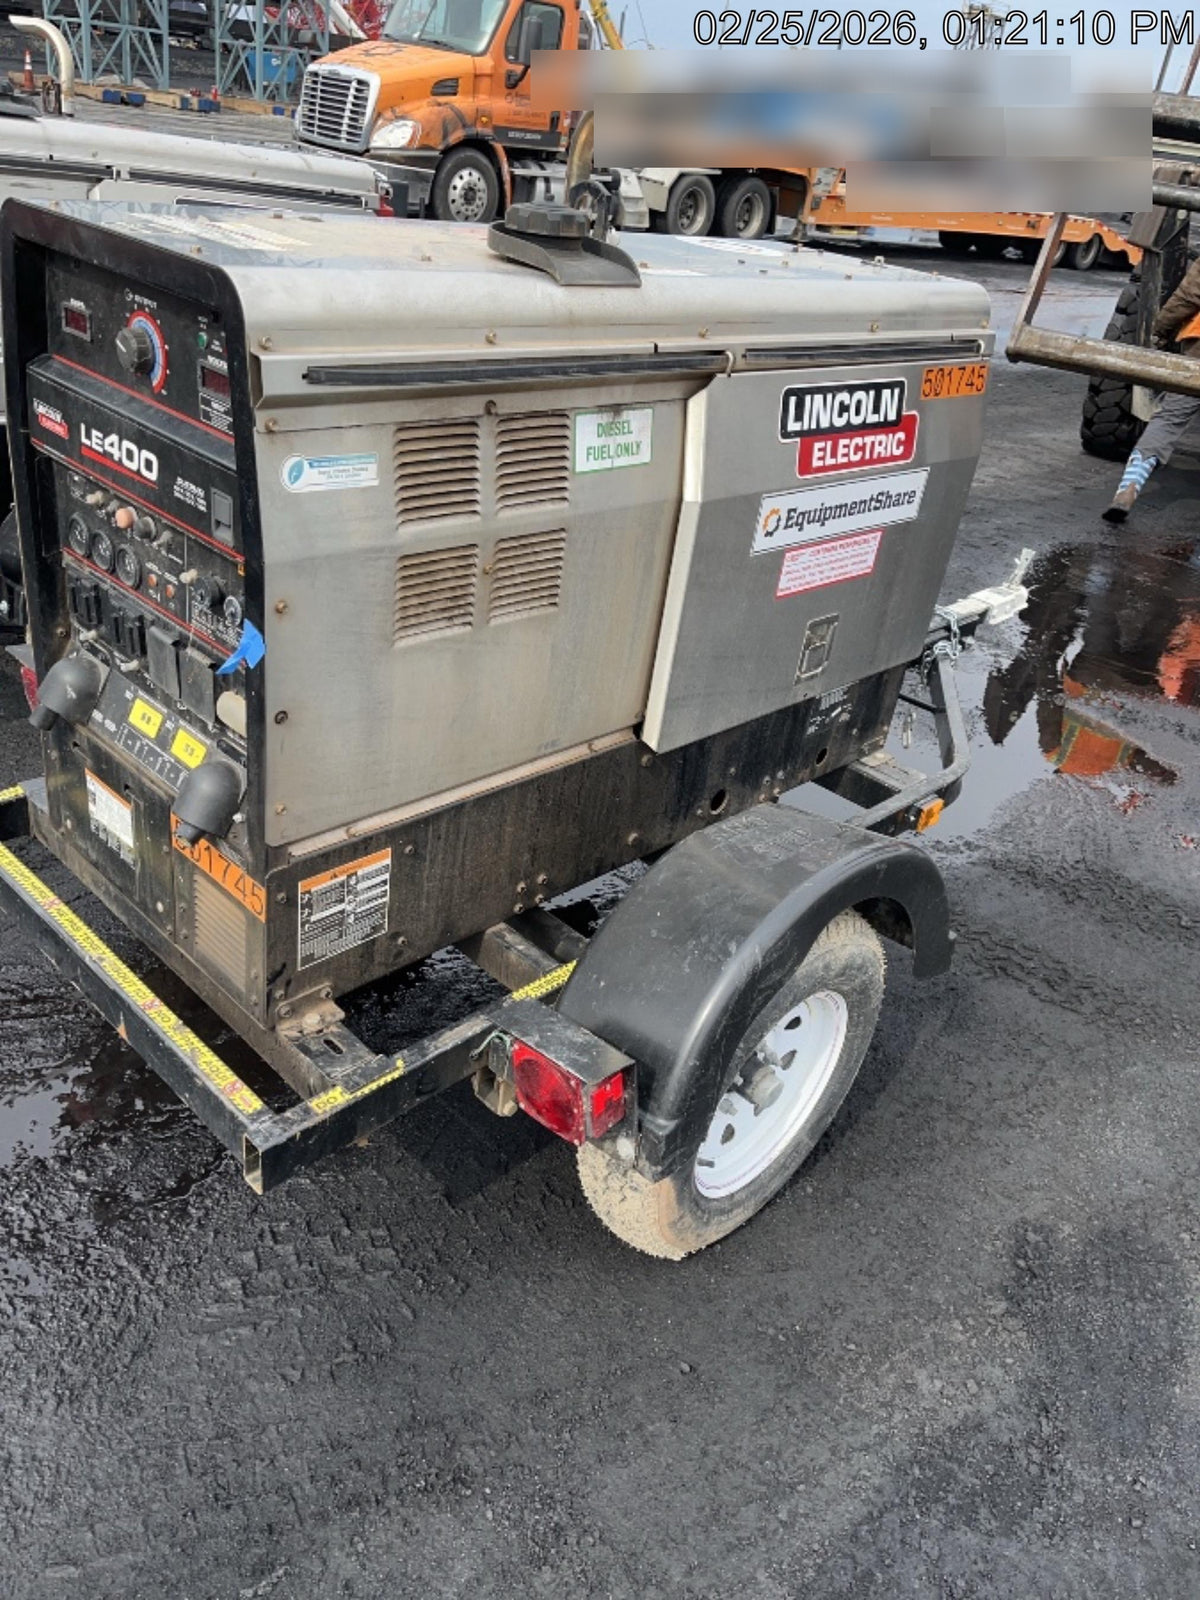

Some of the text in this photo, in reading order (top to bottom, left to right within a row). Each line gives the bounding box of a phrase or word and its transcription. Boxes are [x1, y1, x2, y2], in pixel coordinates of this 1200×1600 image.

[922, 366, 986, 397] 501745
[787, 387, 900, 432] LINCOLN
[597, 420, 633, 438] DIESEL
[80, 422, 159, 482] LE400
[586, 441, 642, 462] FUEL ONLY
[811, 432, 905, 467] ELECTRIC
[783, 489, 917, 532] EquipmentShare
